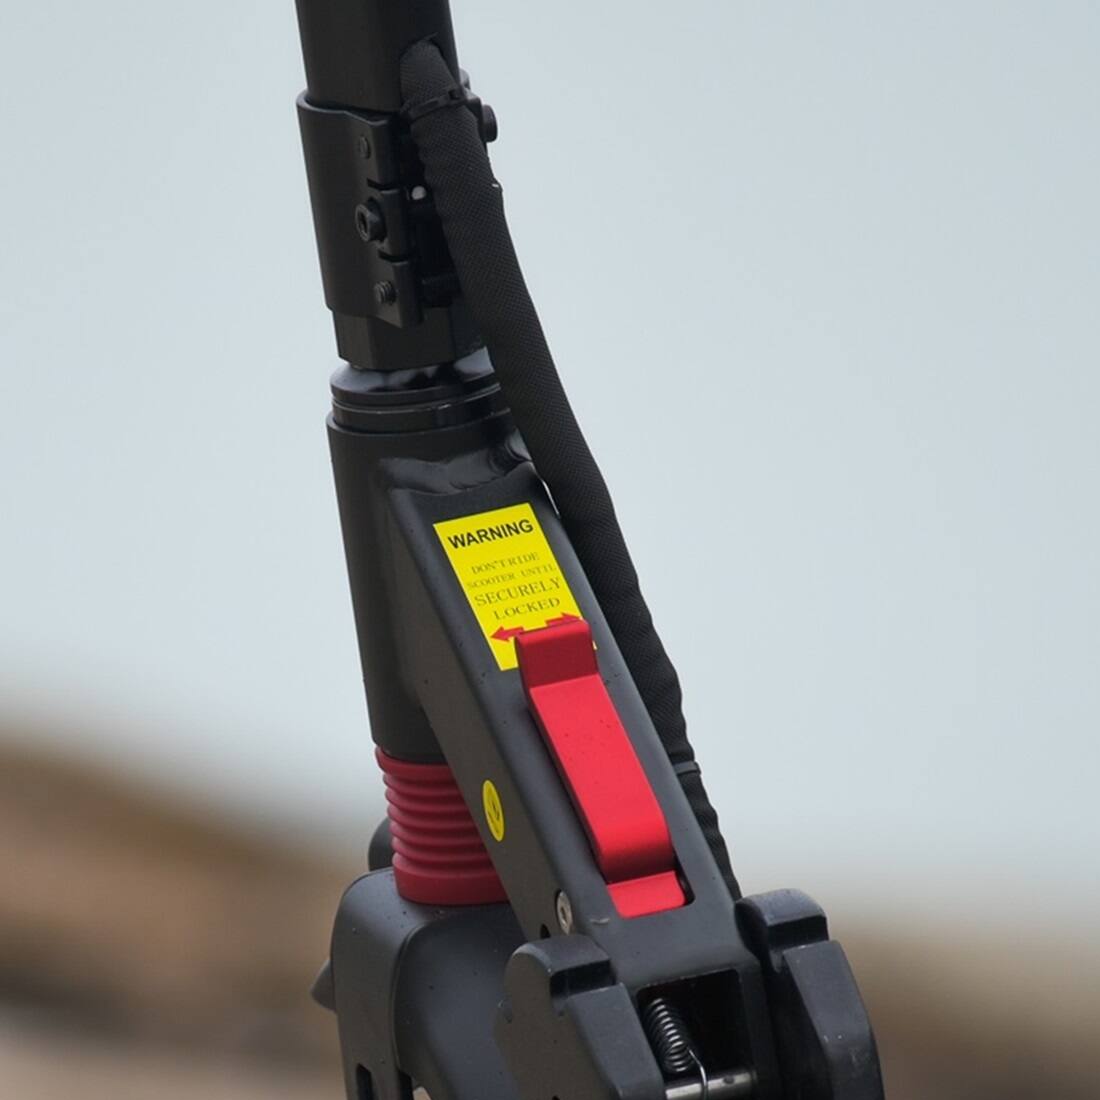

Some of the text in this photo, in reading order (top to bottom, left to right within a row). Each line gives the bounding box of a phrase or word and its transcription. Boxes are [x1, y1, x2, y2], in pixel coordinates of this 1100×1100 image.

[448, 519, 534, 549] WARNING
[467, 563, 557, 588] SCOOTER UNTIL
[474, 576, 561, 607] SECURELY
[493, 597, 561, 620] LOCKED
